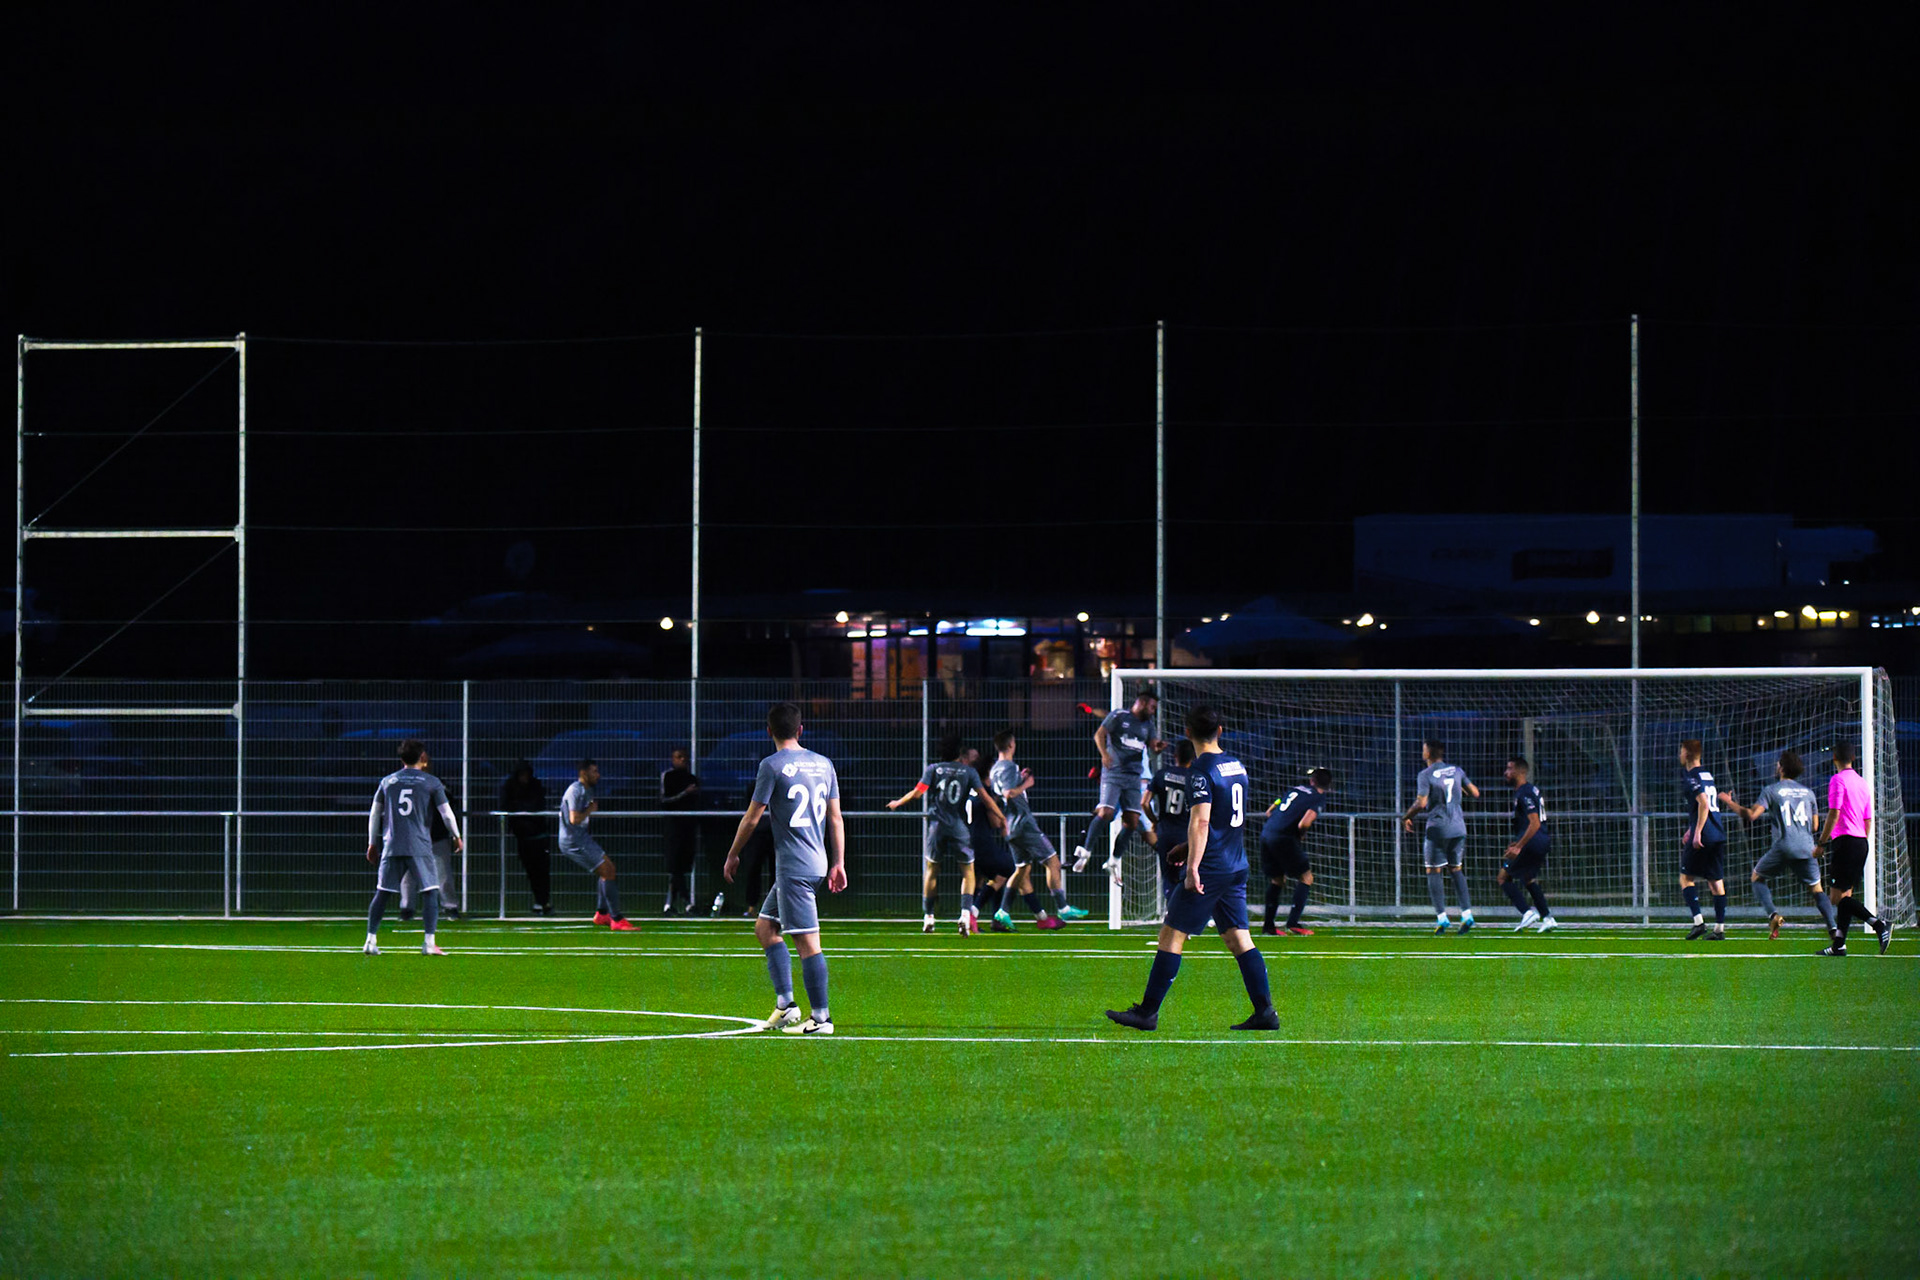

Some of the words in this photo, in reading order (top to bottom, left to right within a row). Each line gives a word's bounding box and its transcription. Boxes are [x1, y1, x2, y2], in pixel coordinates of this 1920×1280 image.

[398, 789, 413, 816] 5
[936, 779, 961, 805] 10
[1165, 786, 1185, 816] 19
[1279, 792, 1299, 812] 3
[1443, 778, 1455, 803] 7
[787, 783, 828, 828] 26
[1230, 783, 1244, 828] 9
[1781, 799, 1809, 827] 14
